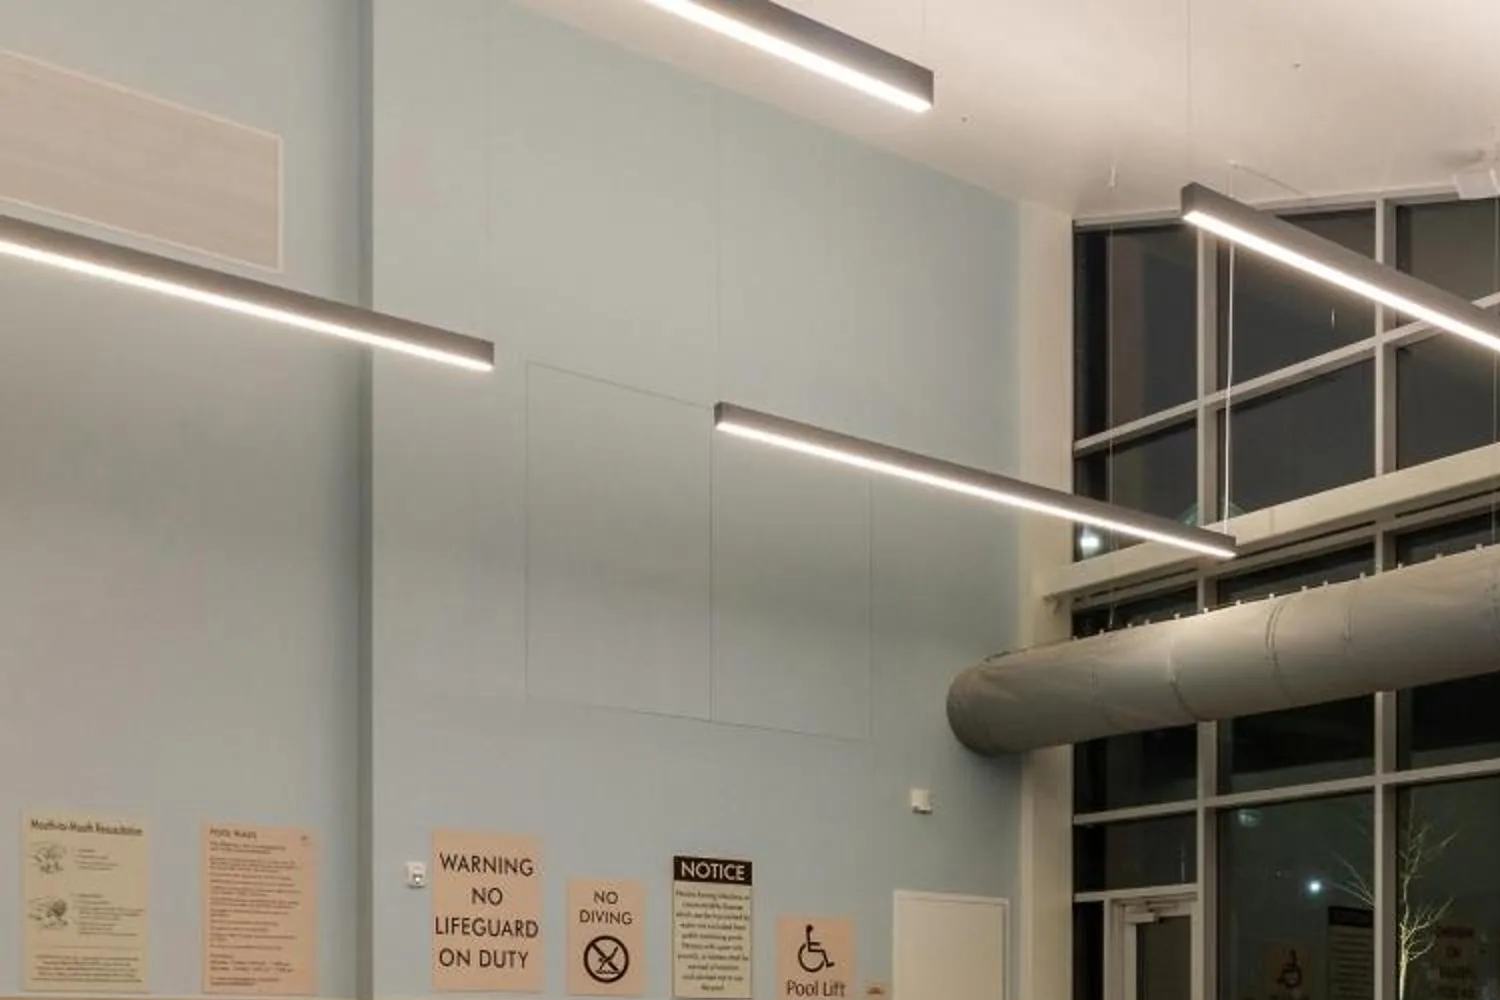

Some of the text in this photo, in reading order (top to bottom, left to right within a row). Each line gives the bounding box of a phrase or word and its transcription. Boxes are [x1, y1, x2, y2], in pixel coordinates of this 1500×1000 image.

[439, 852, 534, 877] WARNING
[681, 861, 746, 881] NOTICE
[471, 887, 504, 906] NO
[593, 890, 619, 905] NO
[579, 909, 633, 925] DIVING
[435, 917, 540, 939] LIFEGUARD
[439, 948, 529, 969] ON DUTY
[786, 979, 846, 997] Pool Lift
